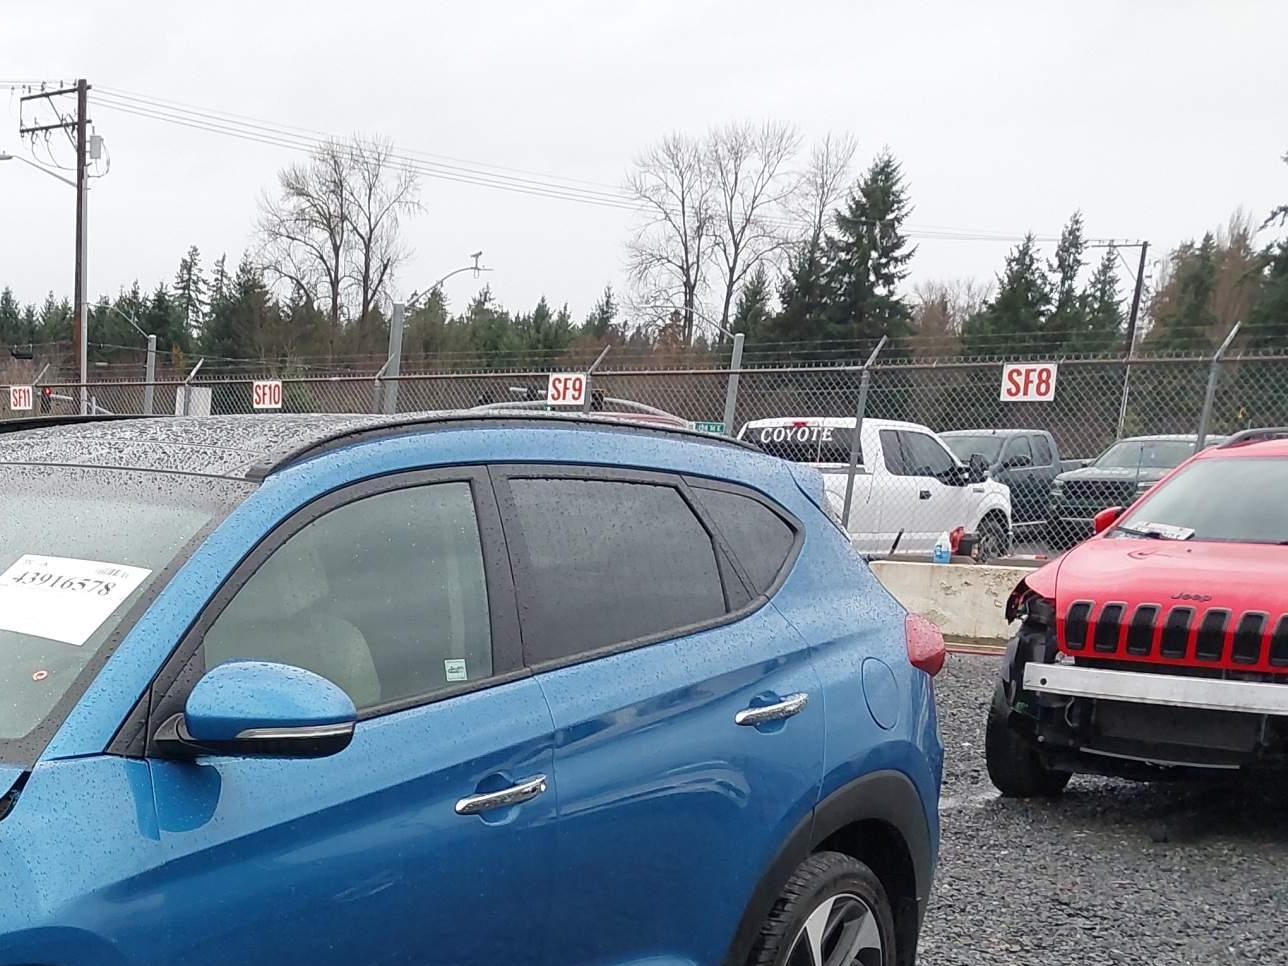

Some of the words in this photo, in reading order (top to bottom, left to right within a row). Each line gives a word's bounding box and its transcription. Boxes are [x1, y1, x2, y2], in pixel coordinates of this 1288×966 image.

[551, 377, 583, 401] SF9
[1006, 368, 1052, 397] SF8
[12, 388, 31, 407] SF11
[254, 384, 281, 405] SF10
[760, 426, 834, 443] COYOTE
[12, 571, 117, 597] 43916578
[1170, 592, 1212, 603] Jeep
